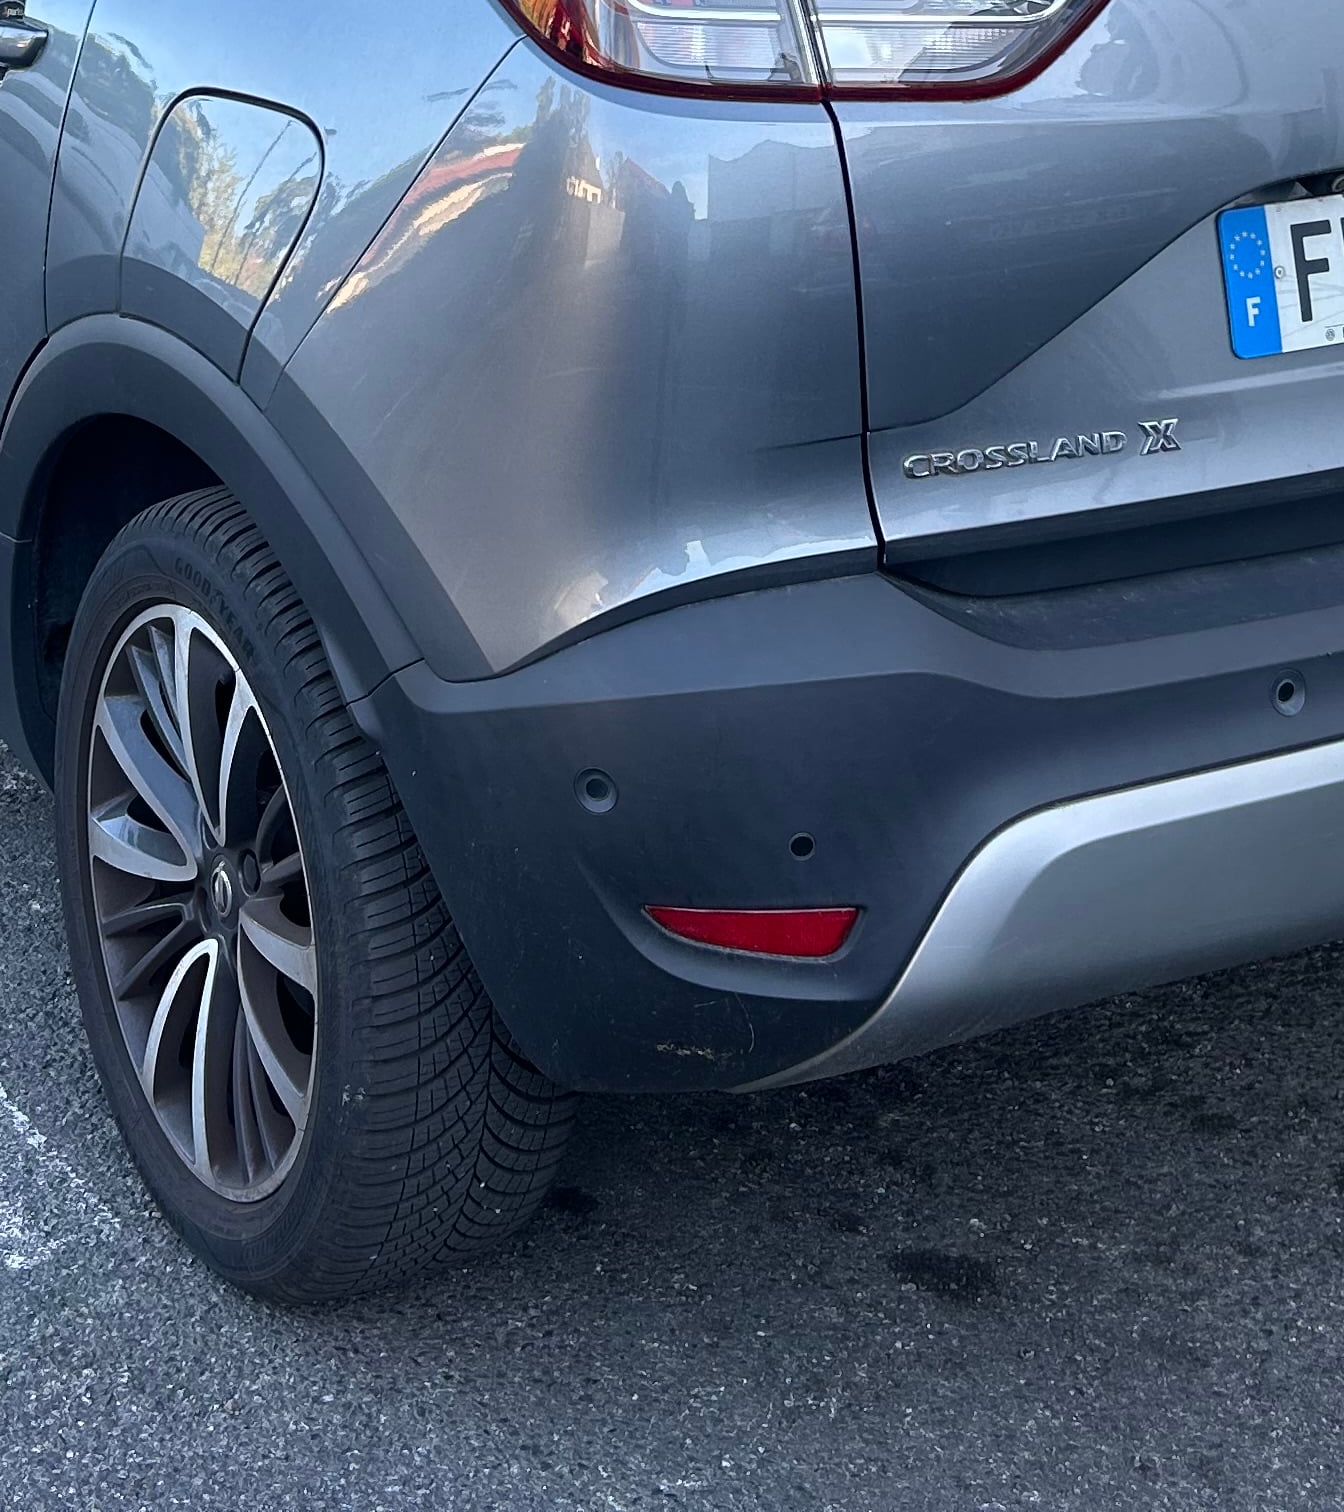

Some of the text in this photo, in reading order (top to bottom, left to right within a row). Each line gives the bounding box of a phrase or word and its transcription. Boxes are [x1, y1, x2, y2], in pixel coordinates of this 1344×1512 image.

[1246, 297, 1261, 327] F
[902, 418, 1182, 479] CROSSLAND X
